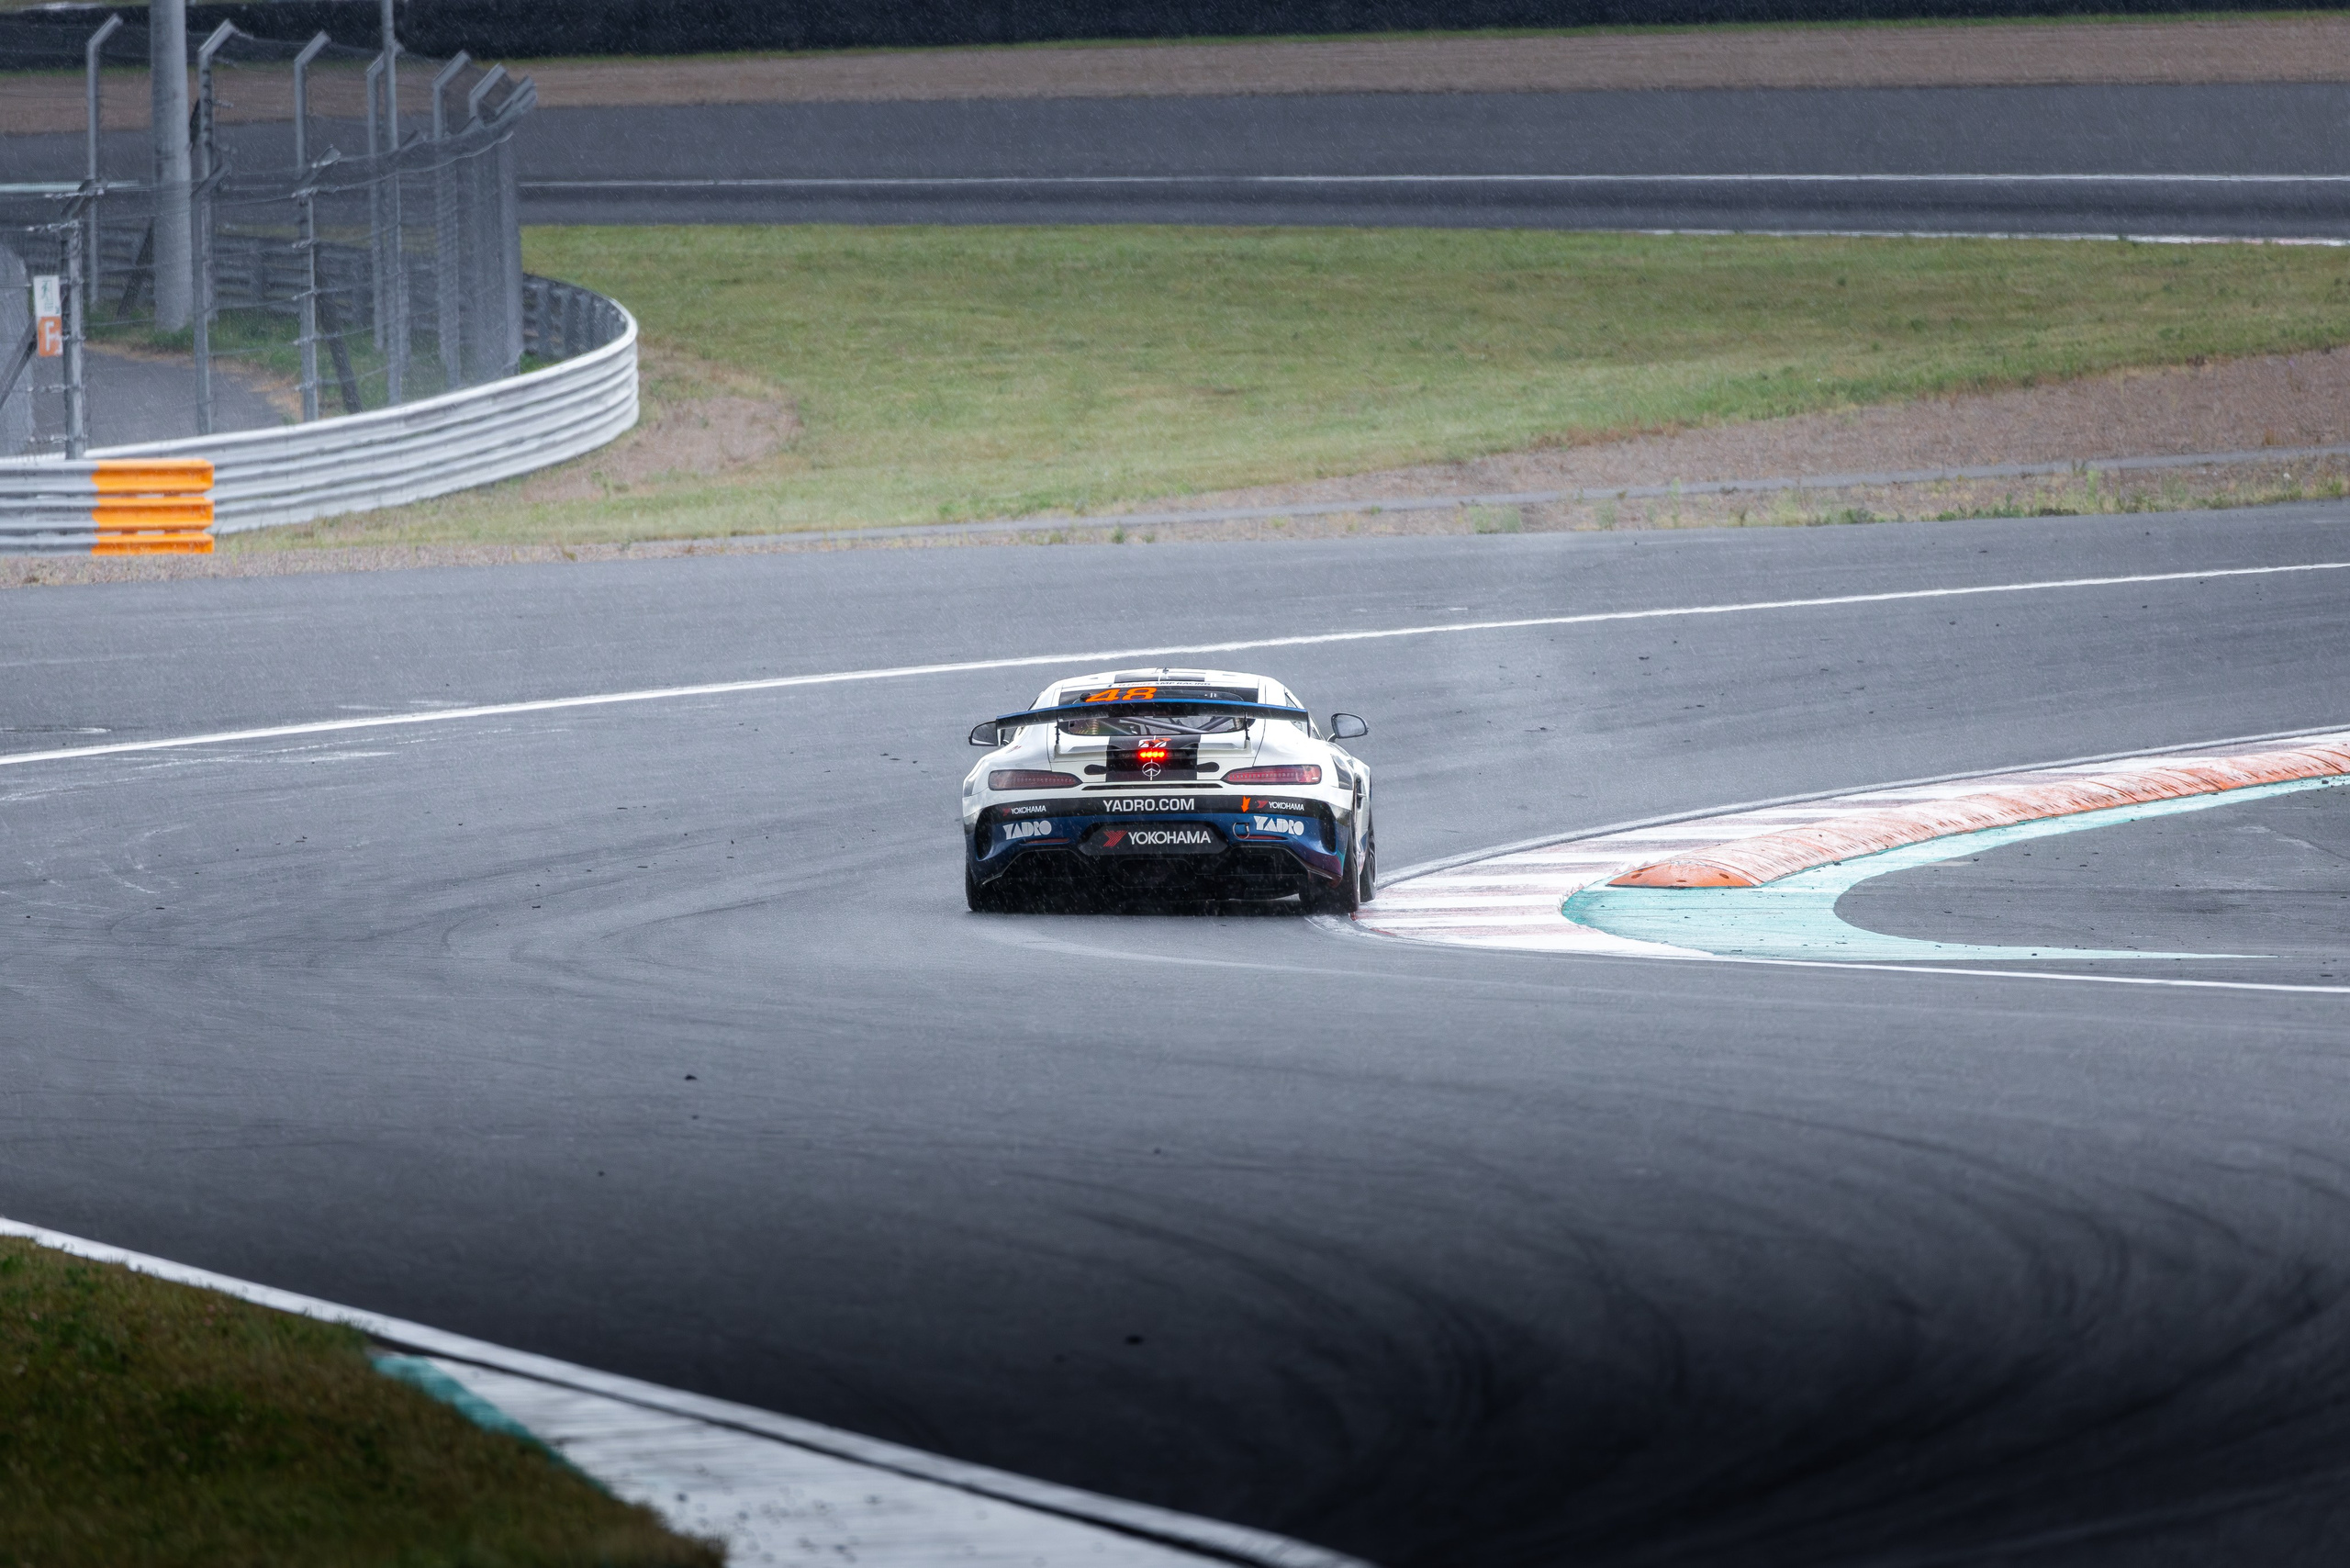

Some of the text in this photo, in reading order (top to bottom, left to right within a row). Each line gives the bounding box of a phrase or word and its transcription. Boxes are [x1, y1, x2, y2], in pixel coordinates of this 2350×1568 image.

[1085, 687, 1158, 702] 48
[1011, 804, 1046, 815] YOKOHAMA
[1102, 798, 1195, 812] YADRO.COM
[1269, 801, 1304, 812] YOKOHAMA
[1002, 820, 1052, 840] YADRO
[1253, 815, 1304, 836] YADRO
[1127, 830, 1212, 846] YOKOHAMA
